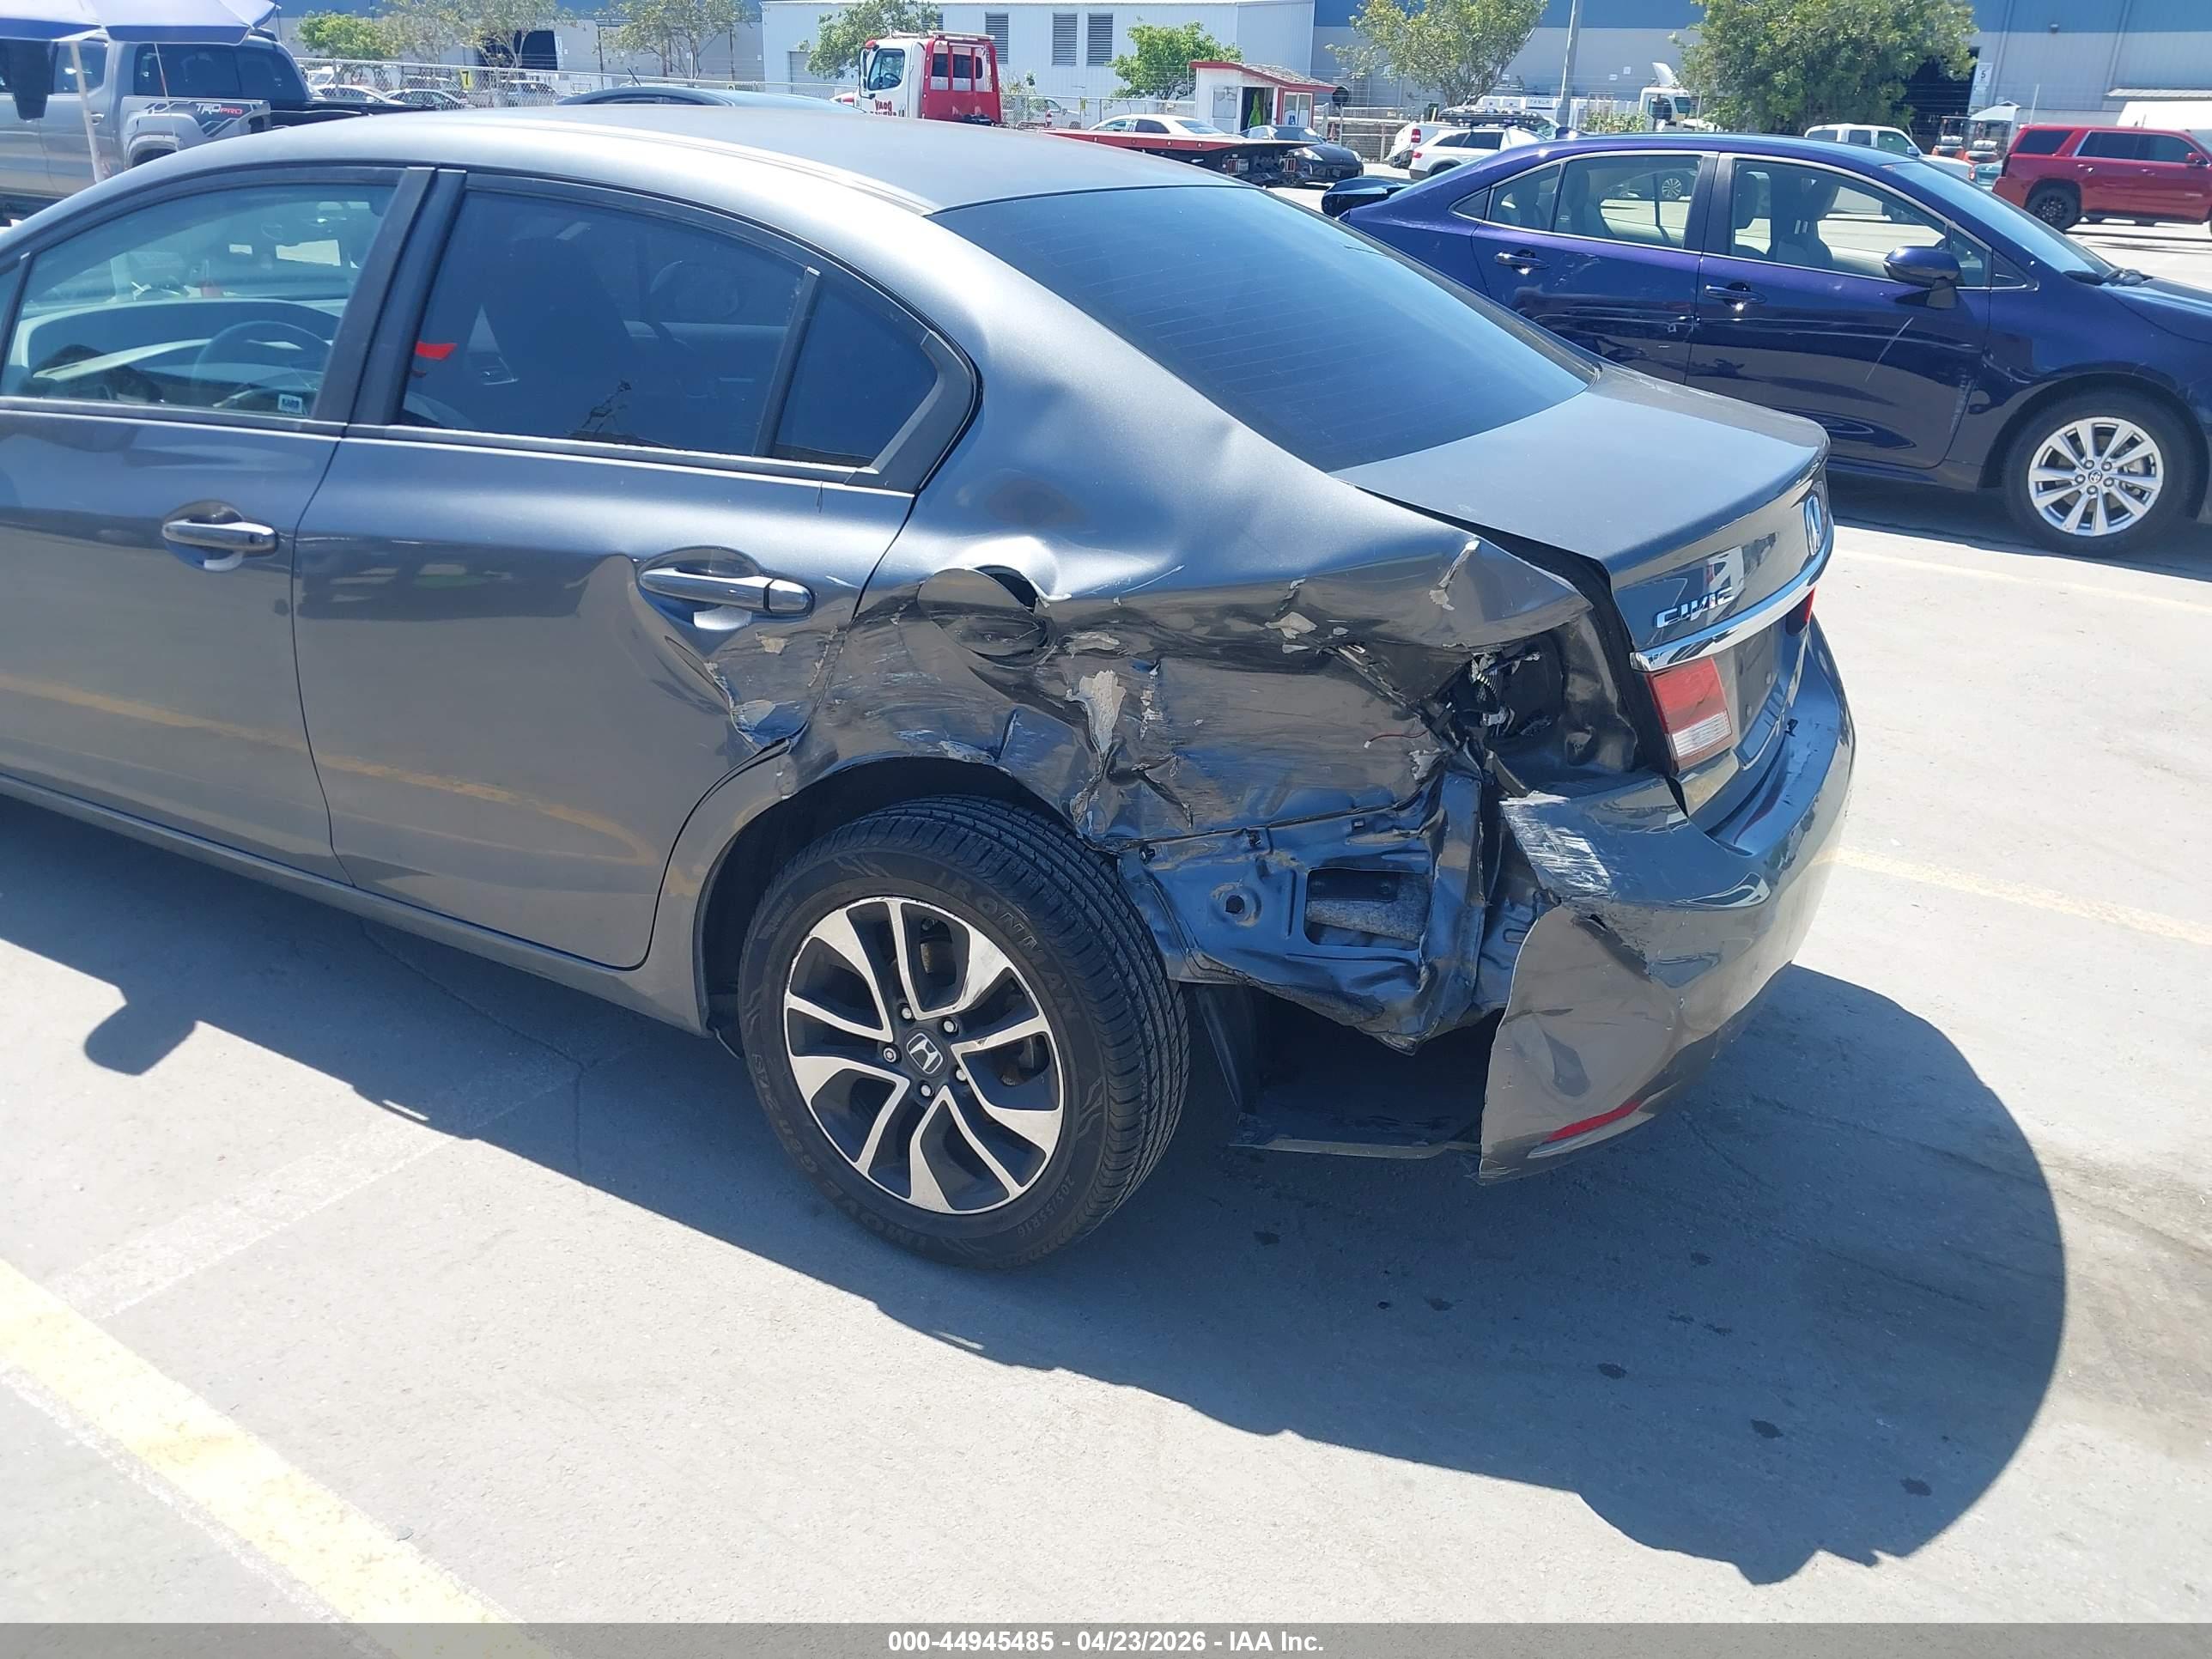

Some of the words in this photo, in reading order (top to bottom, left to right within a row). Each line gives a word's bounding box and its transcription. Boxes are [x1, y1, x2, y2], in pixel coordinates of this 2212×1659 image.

[462, 70, 469, 85] 7
[1980, 70, 1986, 79] 5
[196, 103, 222, 115] TRD
[1656, 586, 1735, 629] CIVIC
[933, 866, 1080, 1024] IRONMAN
[1015, 1173, 1077, 1238] 205/55R16
